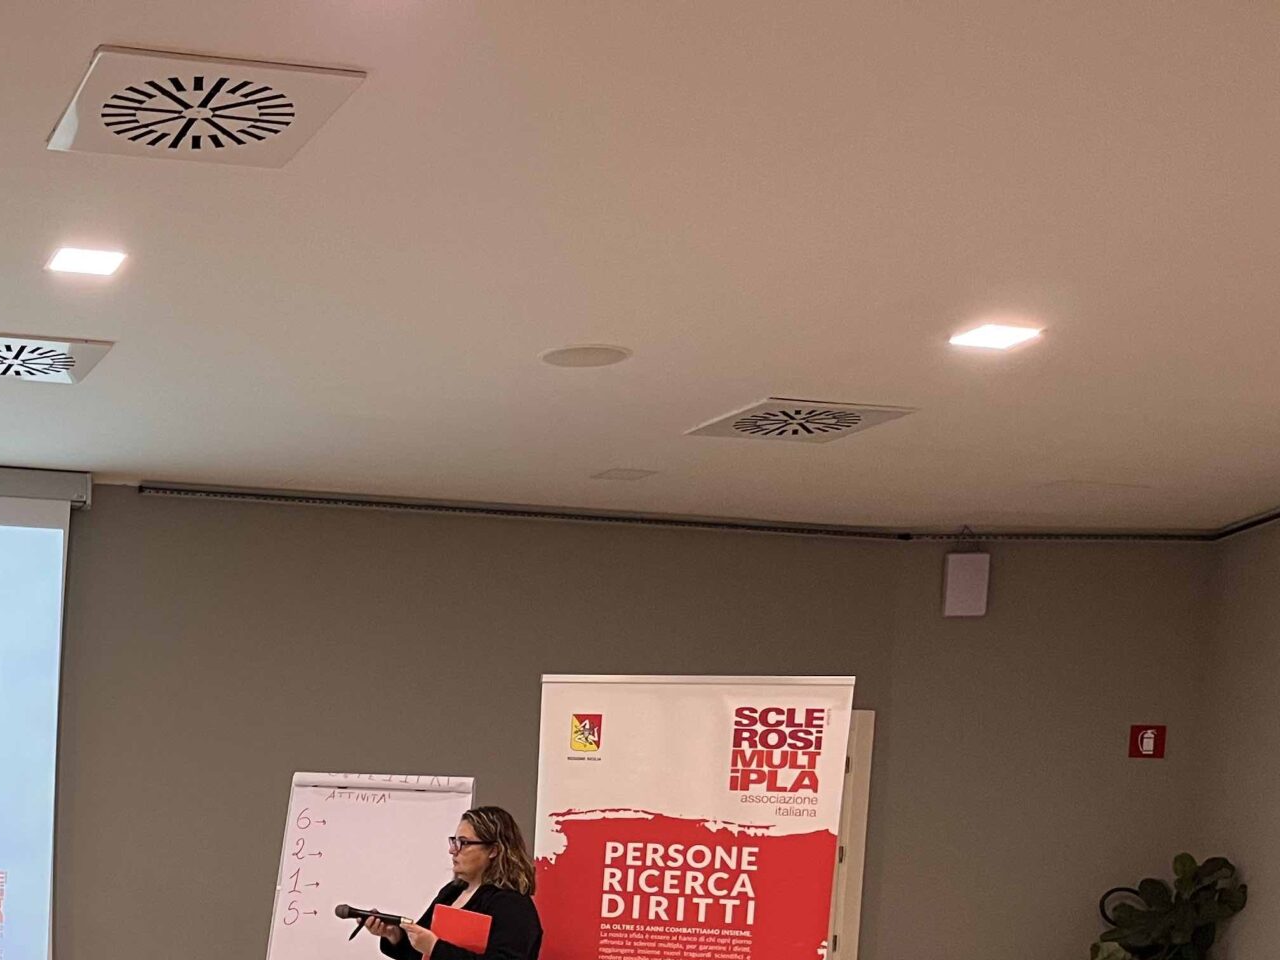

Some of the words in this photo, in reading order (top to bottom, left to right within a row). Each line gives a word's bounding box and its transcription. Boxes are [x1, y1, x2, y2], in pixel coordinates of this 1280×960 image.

[734, 707, 825, 729] SCLE
[731, 749, 821, 770] MULT
[740, 794, 818, 805] associazione
[297, 807, 311, 830] 6
[775, 806, 817, 817] italiana
[291, 837, 305, 860] 2
[604, 841, 760, 871] PERSONE
[288, 868, 301, 893] 1
[602, 867, 755, 898] RICERCA
[601, 893, 756, 925] DIRITTI
[665, 926, 720, 935] COMBATTIAMO
